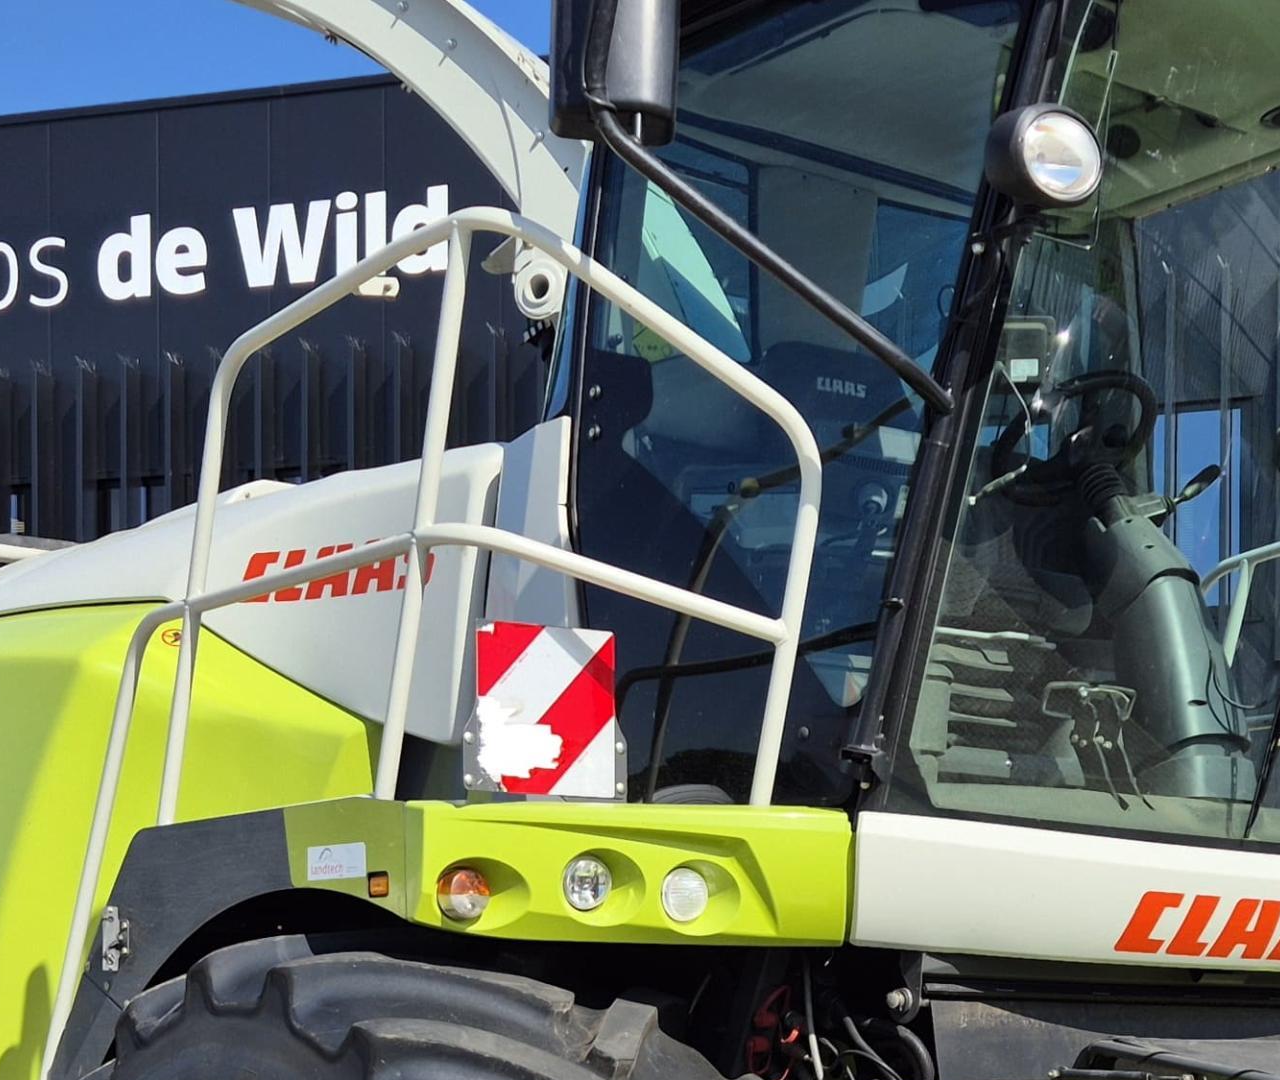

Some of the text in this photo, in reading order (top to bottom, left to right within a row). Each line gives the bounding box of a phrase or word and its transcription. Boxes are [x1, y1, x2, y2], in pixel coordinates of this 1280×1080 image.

[97, 213, 208, 301] de
[232, 184, 450, 289] Wild
[816, 376, 867, 399] CLAAS
